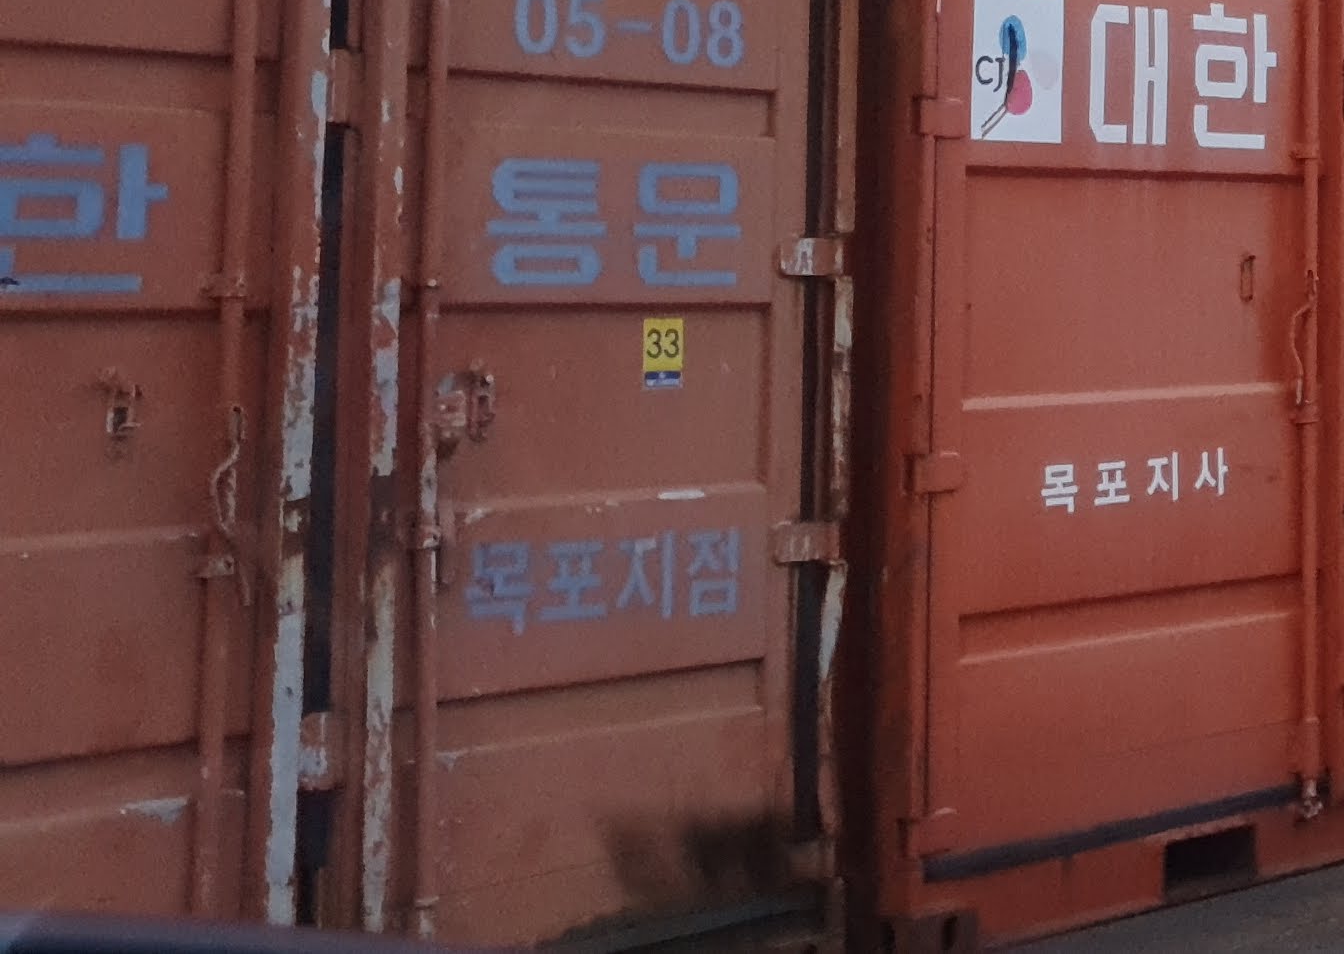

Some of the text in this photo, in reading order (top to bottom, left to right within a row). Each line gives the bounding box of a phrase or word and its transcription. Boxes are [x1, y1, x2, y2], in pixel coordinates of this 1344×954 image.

[975, 55, 1007, 92] CJ
[1089, 2, 1277, 150] 대한
[646, 328, 680, 360] 33
[1040, 448, 1229, 513] 목포지사
[464, 526, 741, 636] 목포지점
